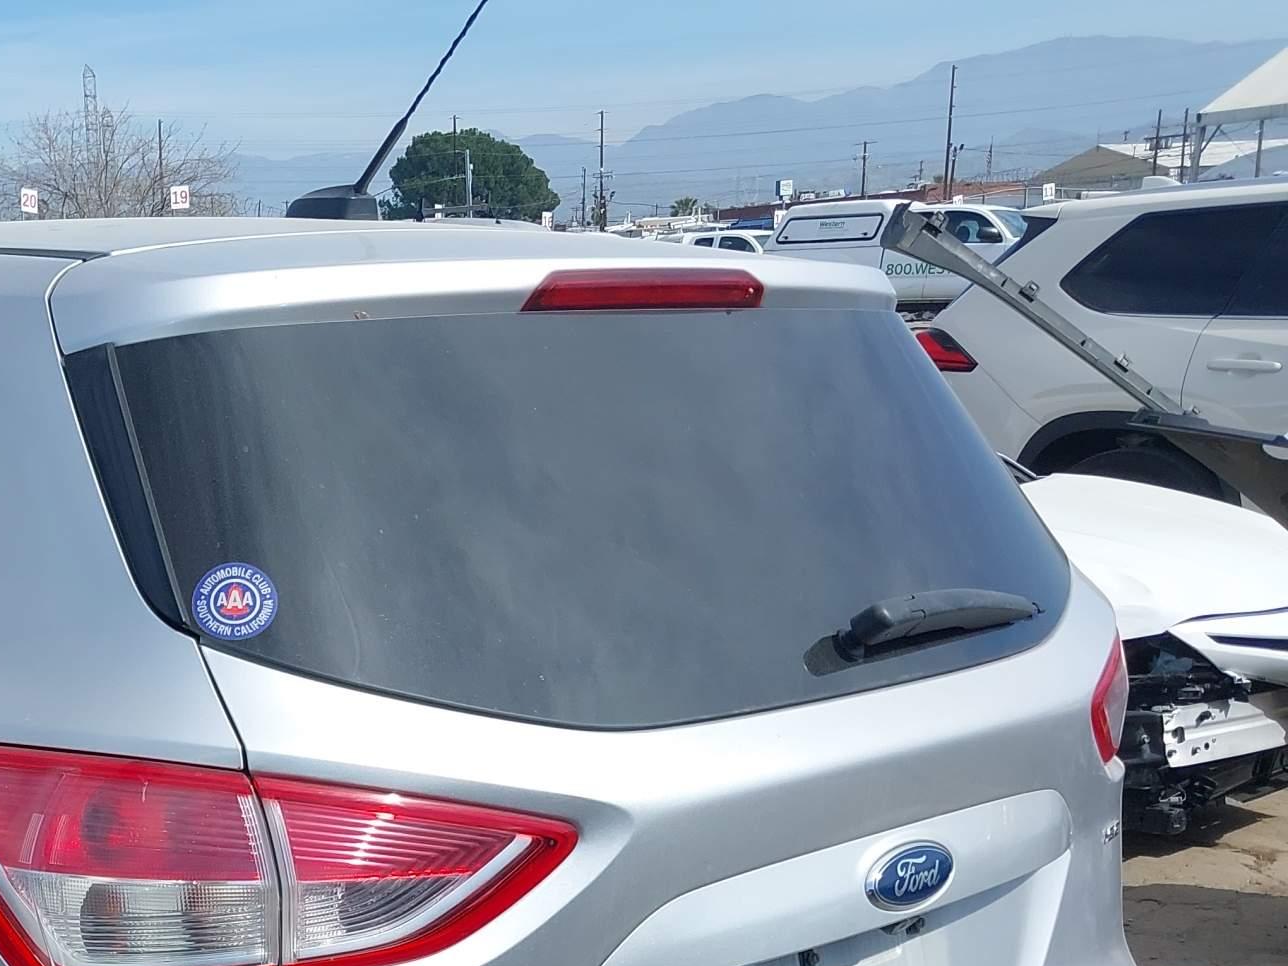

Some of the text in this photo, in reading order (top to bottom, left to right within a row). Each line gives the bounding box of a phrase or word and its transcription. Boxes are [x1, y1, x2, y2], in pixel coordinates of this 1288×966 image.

[22, 193, 37, 208] 20
[172, 190, 188, 205] 19
[885, 263, 952, 275] 800.WES
[200, 566, 272, 596] AUTOMOBILE CLUB
[216, 589, 254, 609] AAA
[196, 599, 274, 636] SOUTHERN CALIFORNIA
[894, 855, 941, 897] Ford
